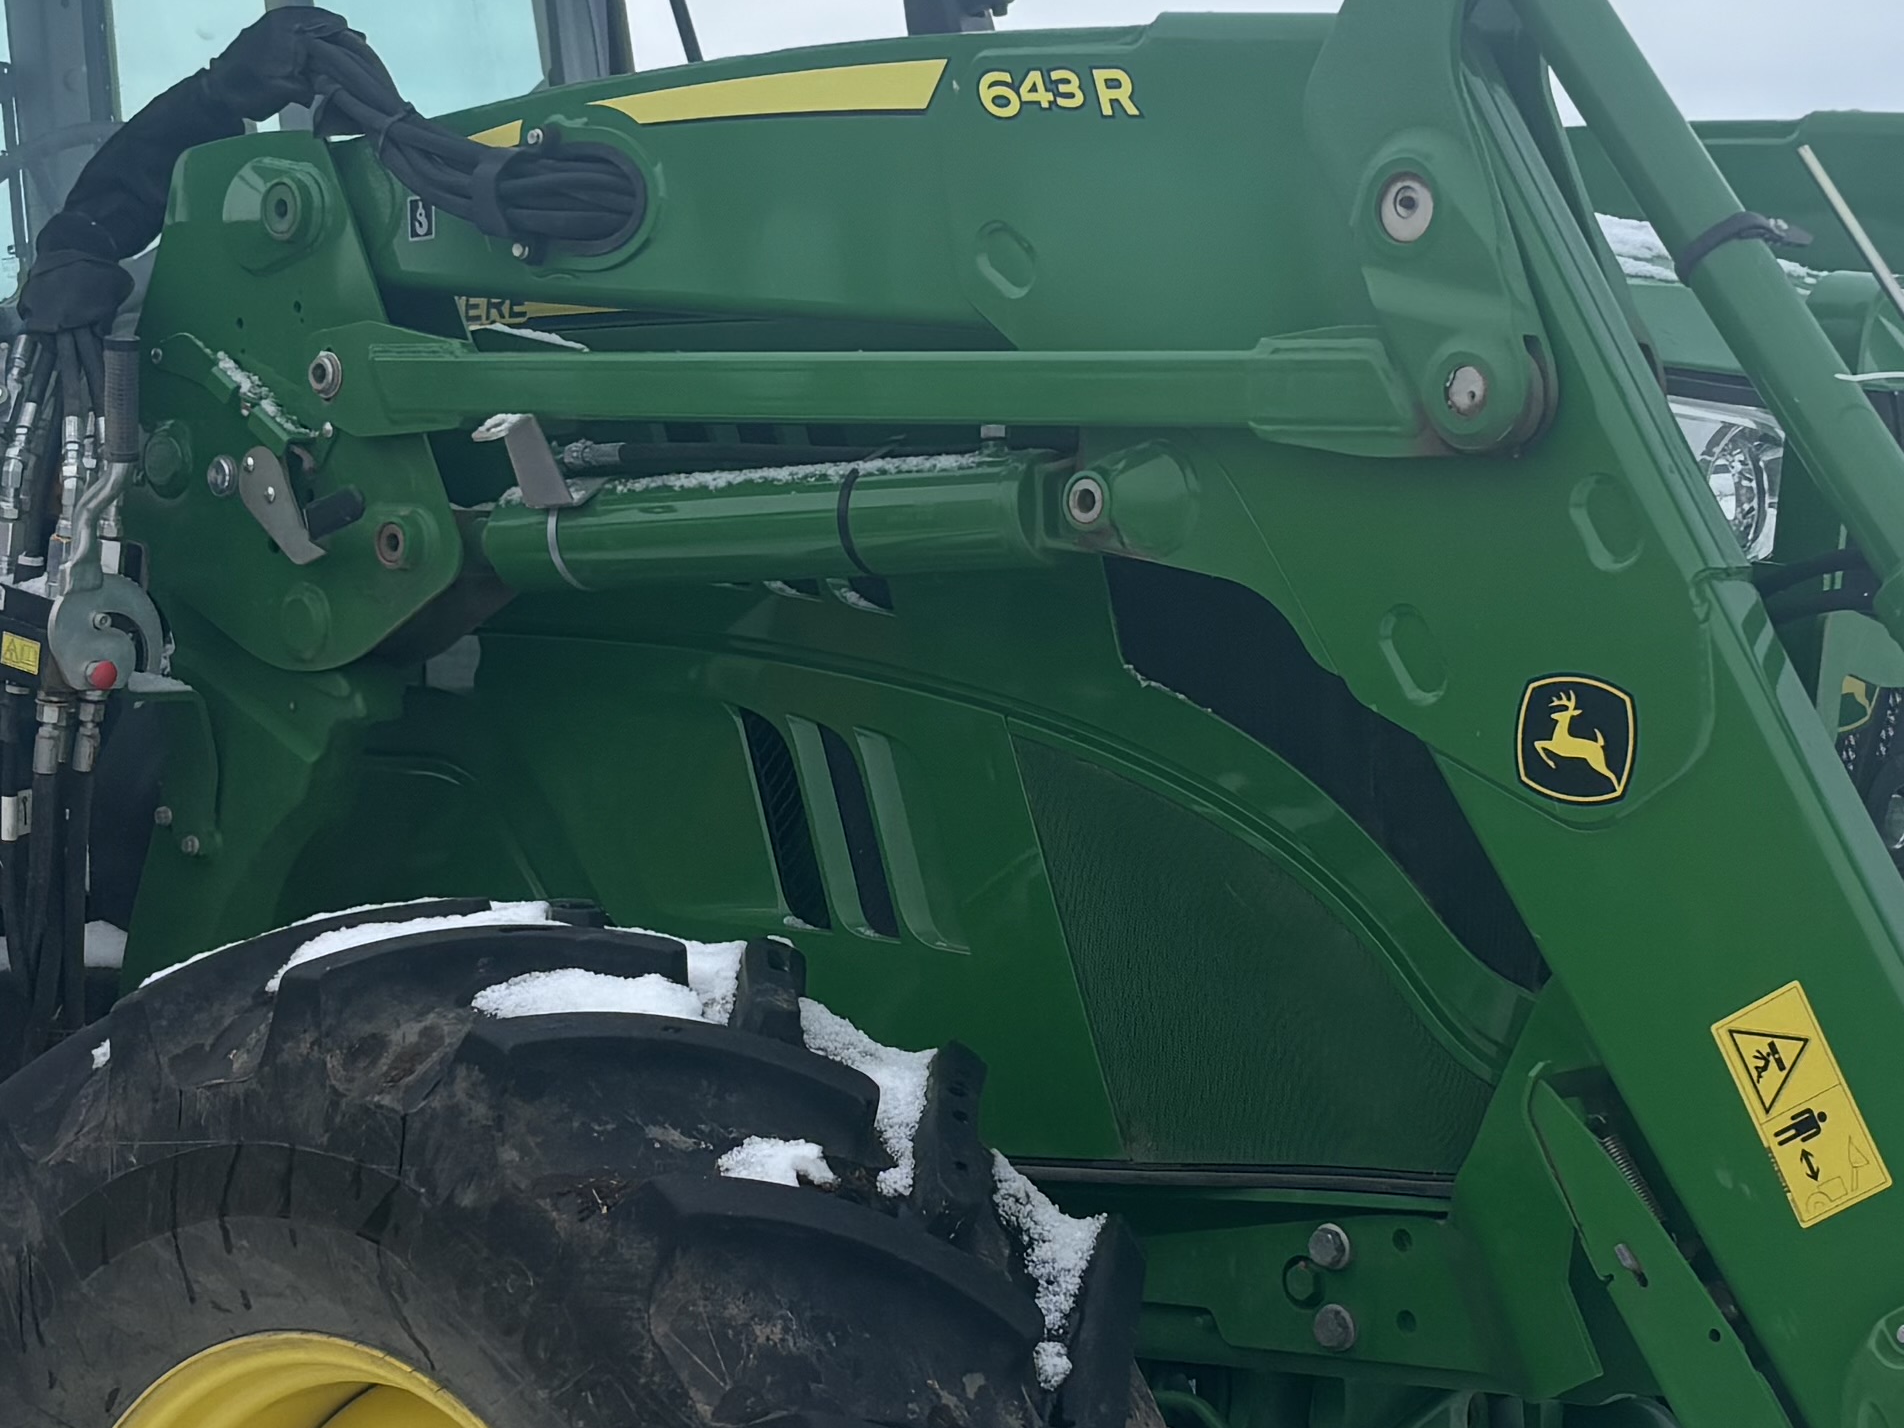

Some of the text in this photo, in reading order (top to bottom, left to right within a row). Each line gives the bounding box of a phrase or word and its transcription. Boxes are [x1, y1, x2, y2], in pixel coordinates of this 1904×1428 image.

[977, 67, 1142, 119] 643 R
[464, 296, 528, 324] ERE
